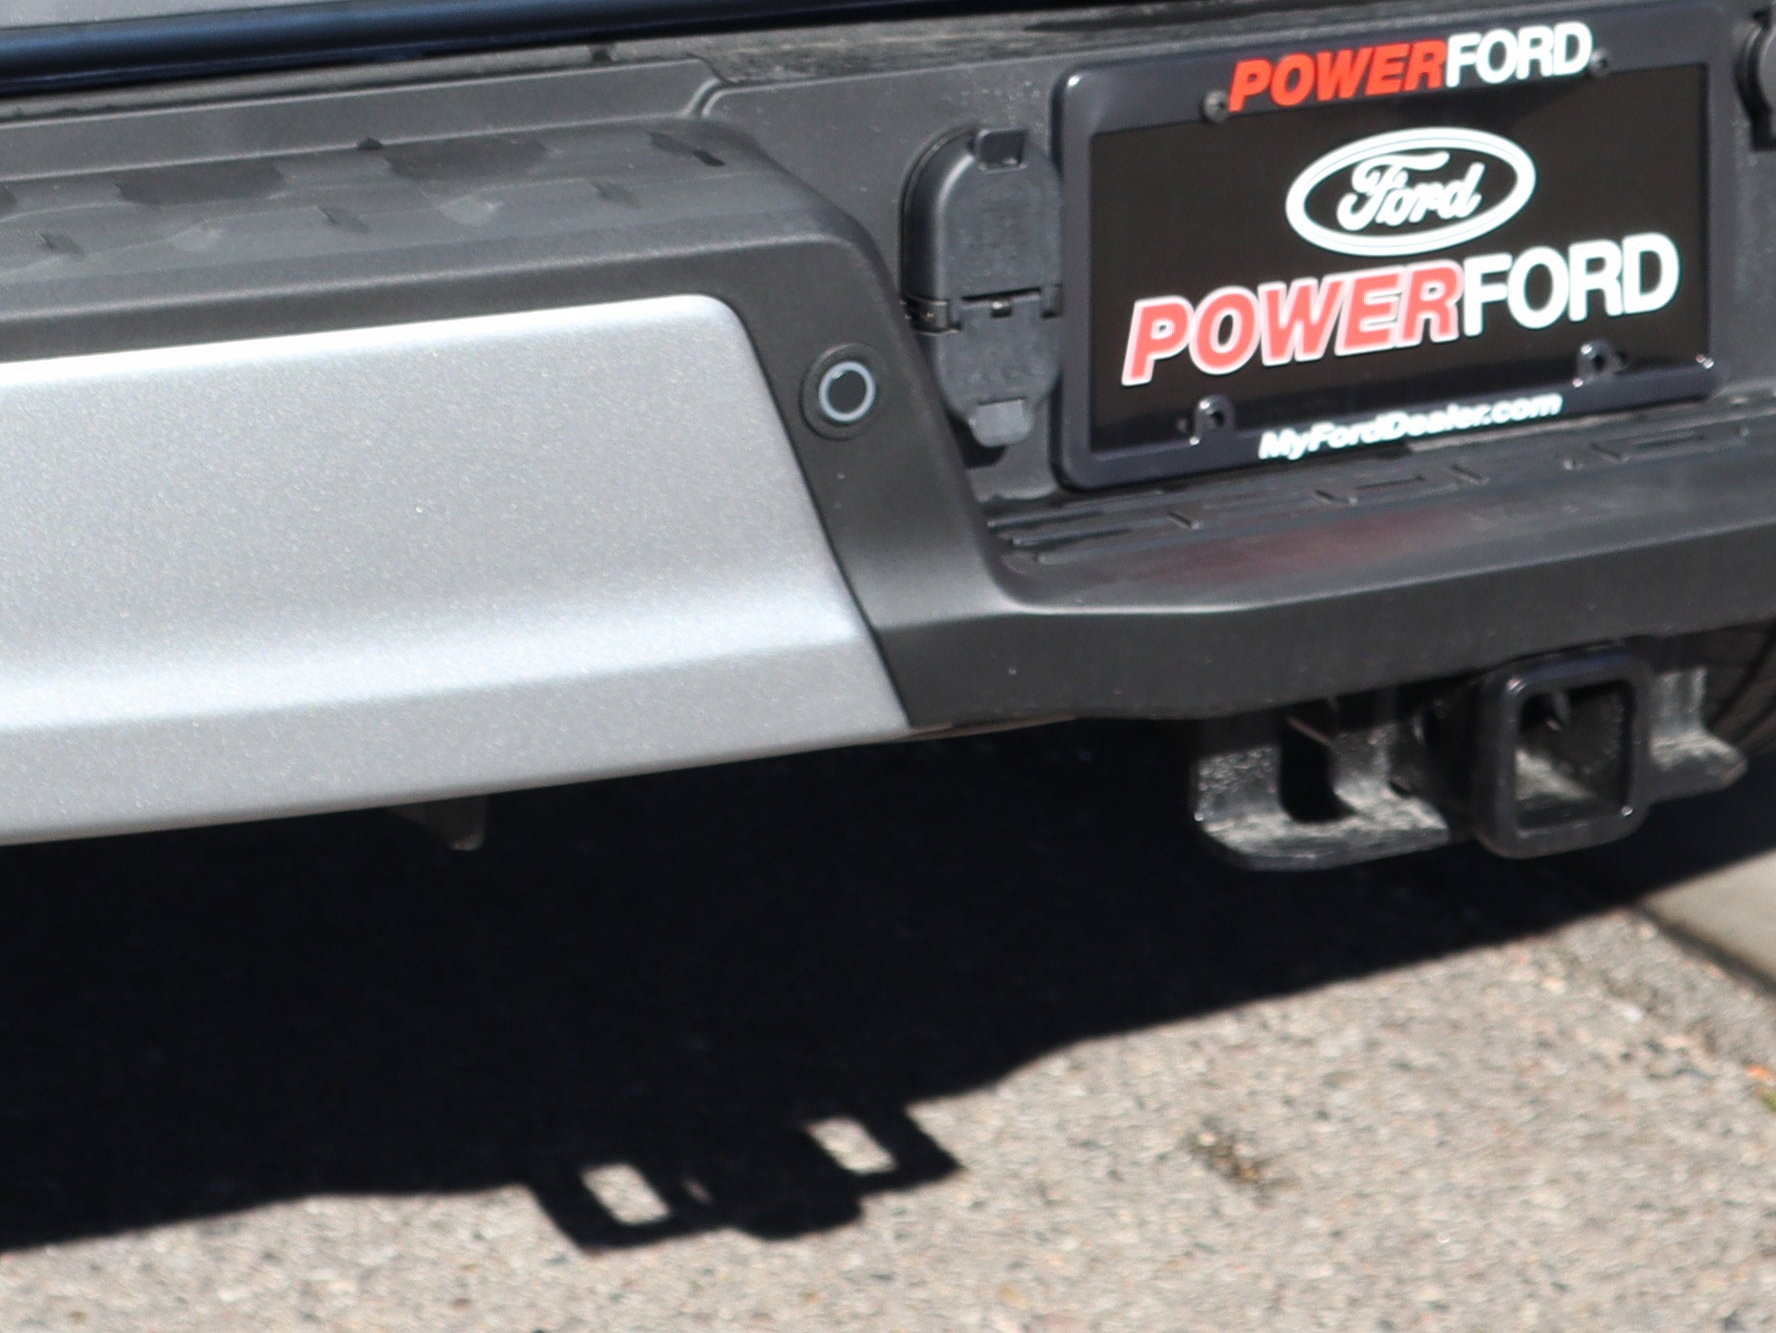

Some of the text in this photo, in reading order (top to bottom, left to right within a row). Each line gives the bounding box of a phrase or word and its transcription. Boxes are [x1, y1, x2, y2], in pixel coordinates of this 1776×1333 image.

[1228, 21, 1593, 113] POWERFORD
[1336, 150, 1486, 231] Ford
[1121, 232, 1681, 386] POWERFORD
[1258, 392, 1564, 461] MyFordDealer.com
